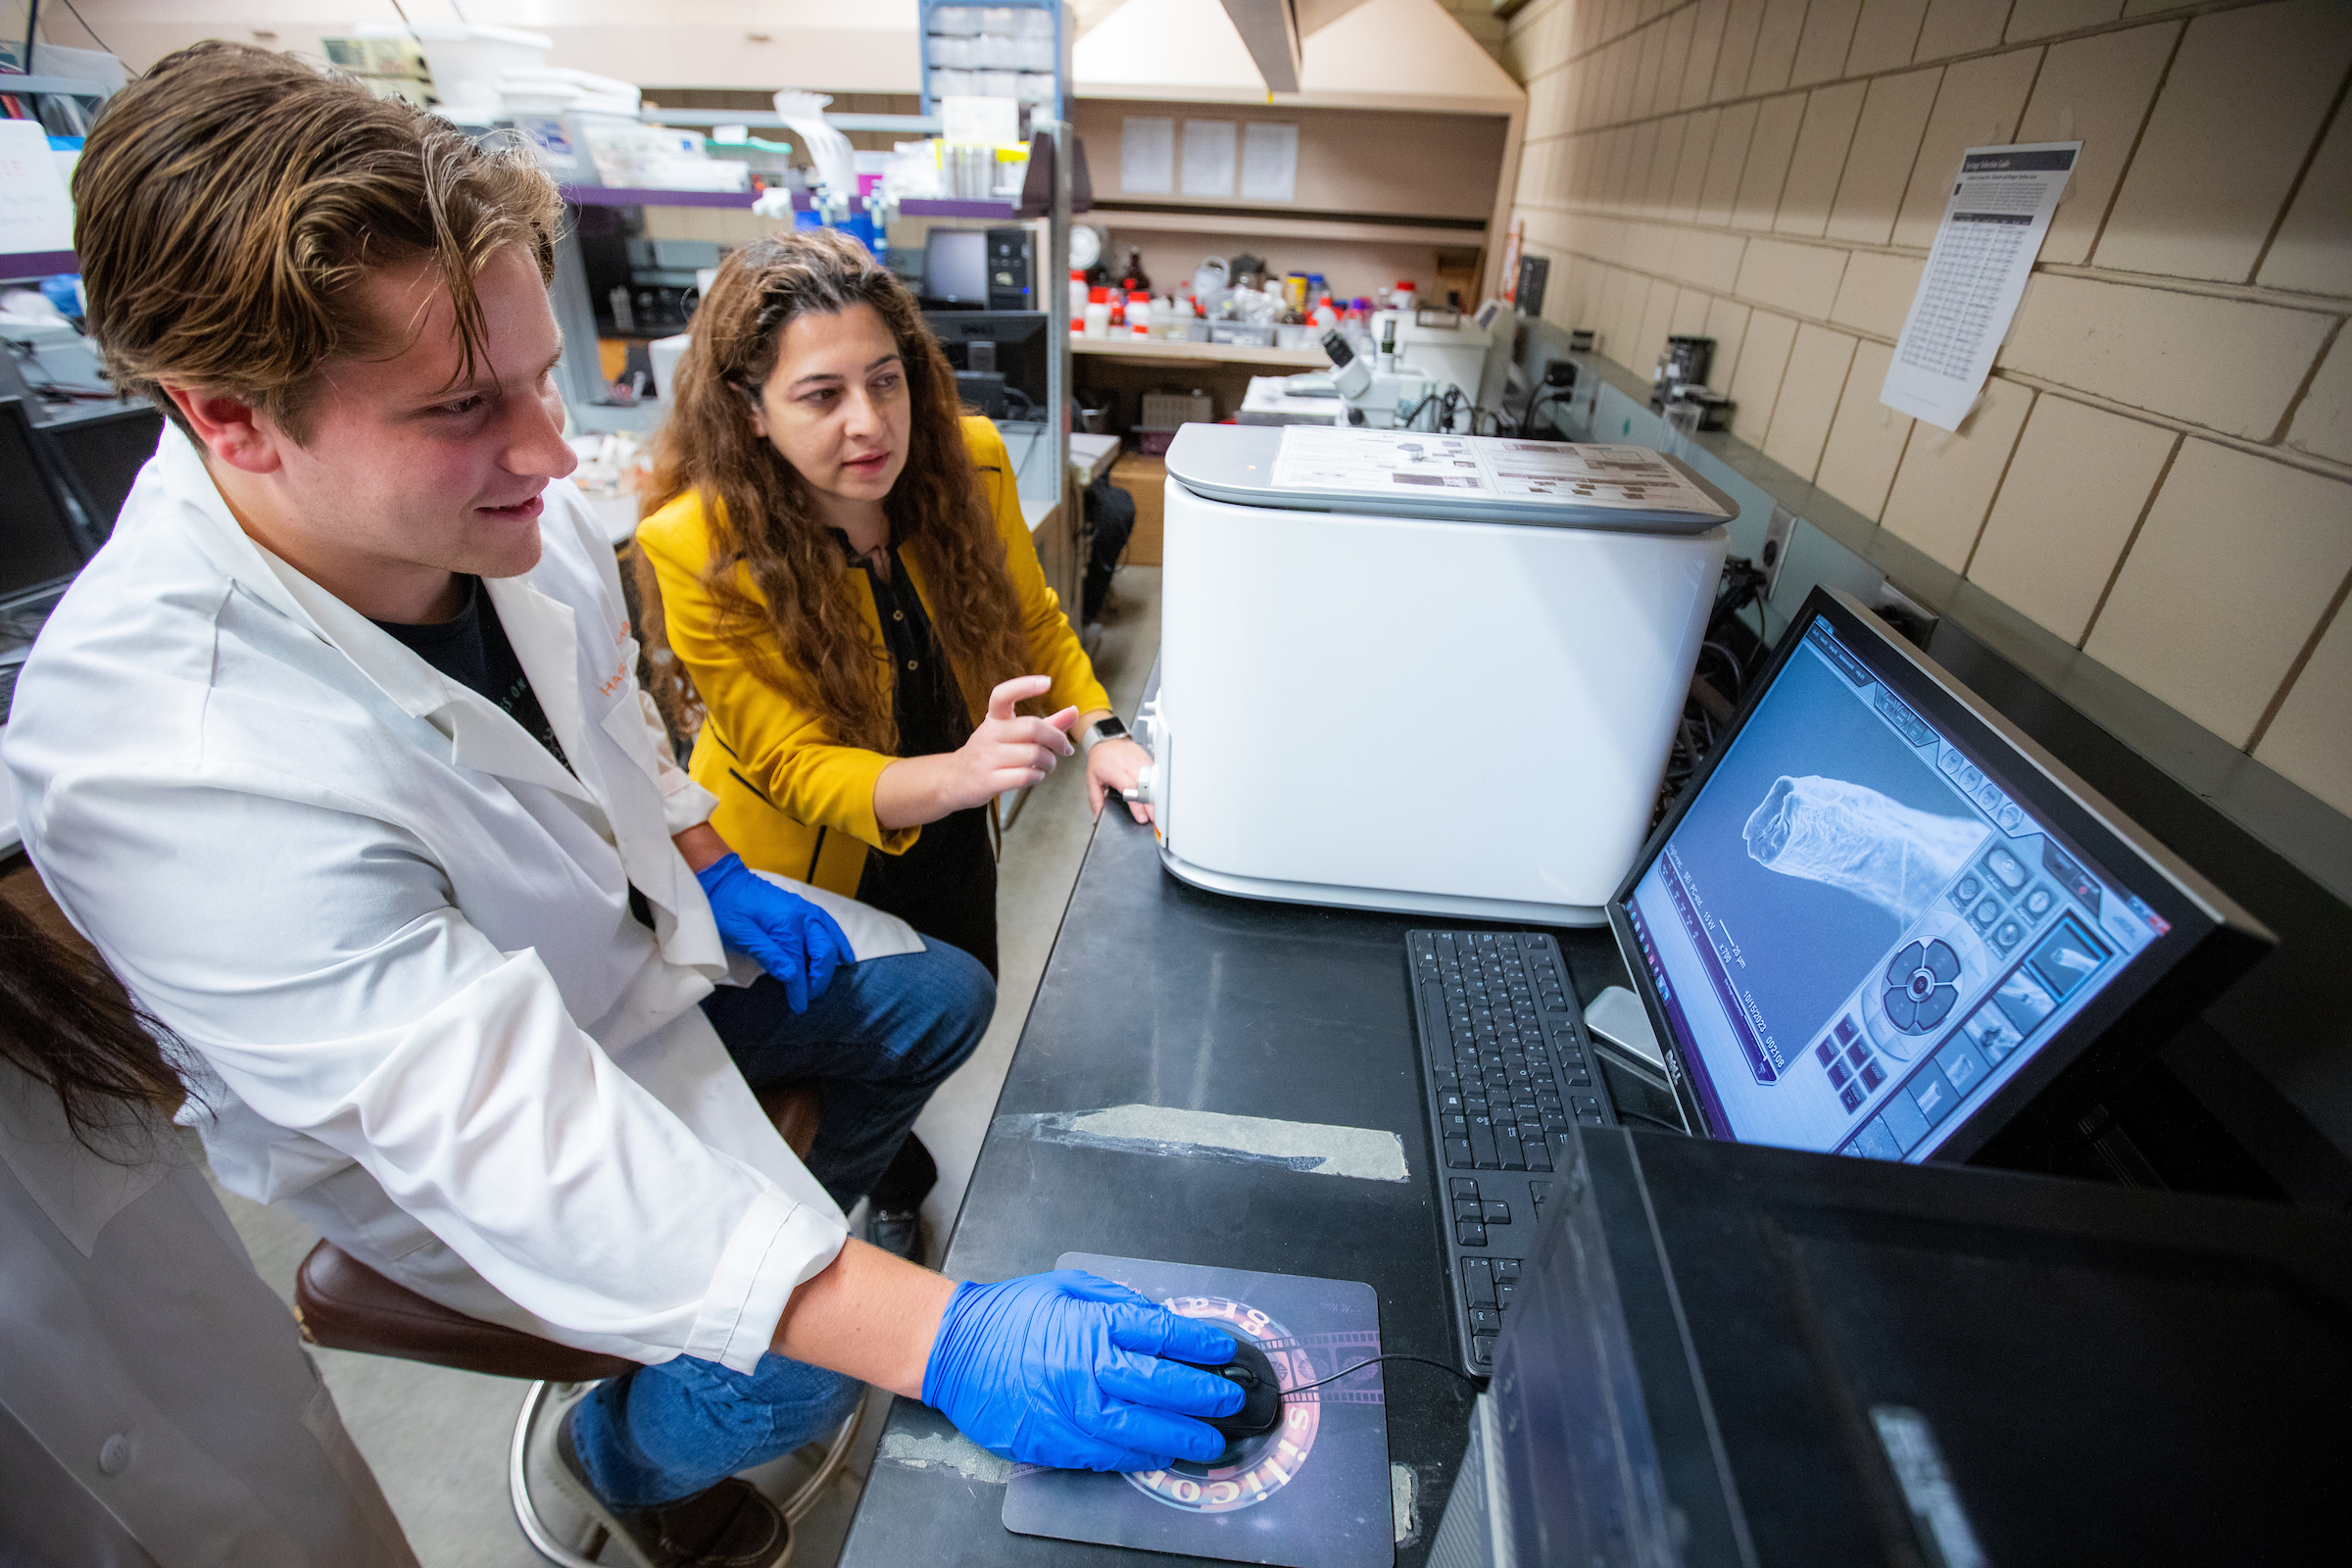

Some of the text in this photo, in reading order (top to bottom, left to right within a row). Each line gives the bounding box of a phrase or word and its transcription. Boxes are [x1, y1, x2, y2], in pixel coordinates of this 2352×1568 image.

[1950, 898, 1961, 908] Focus
[1968, 919, 1982, 932] Stigma
[1734, 946, 1740, 957] 20
[1683, 872, 1692, 884] SEI
[1704, 911, 1711, 922] 15
[1708, 919, 1715, 931] kV
[1743, 990, 1767, 1033] 10/15/2023
[1766, 1036, 1785, 1068] 002108
[1826, 1043, 1836, 1055] x4000
[1665, 1050, 1681, 1085] DELL
